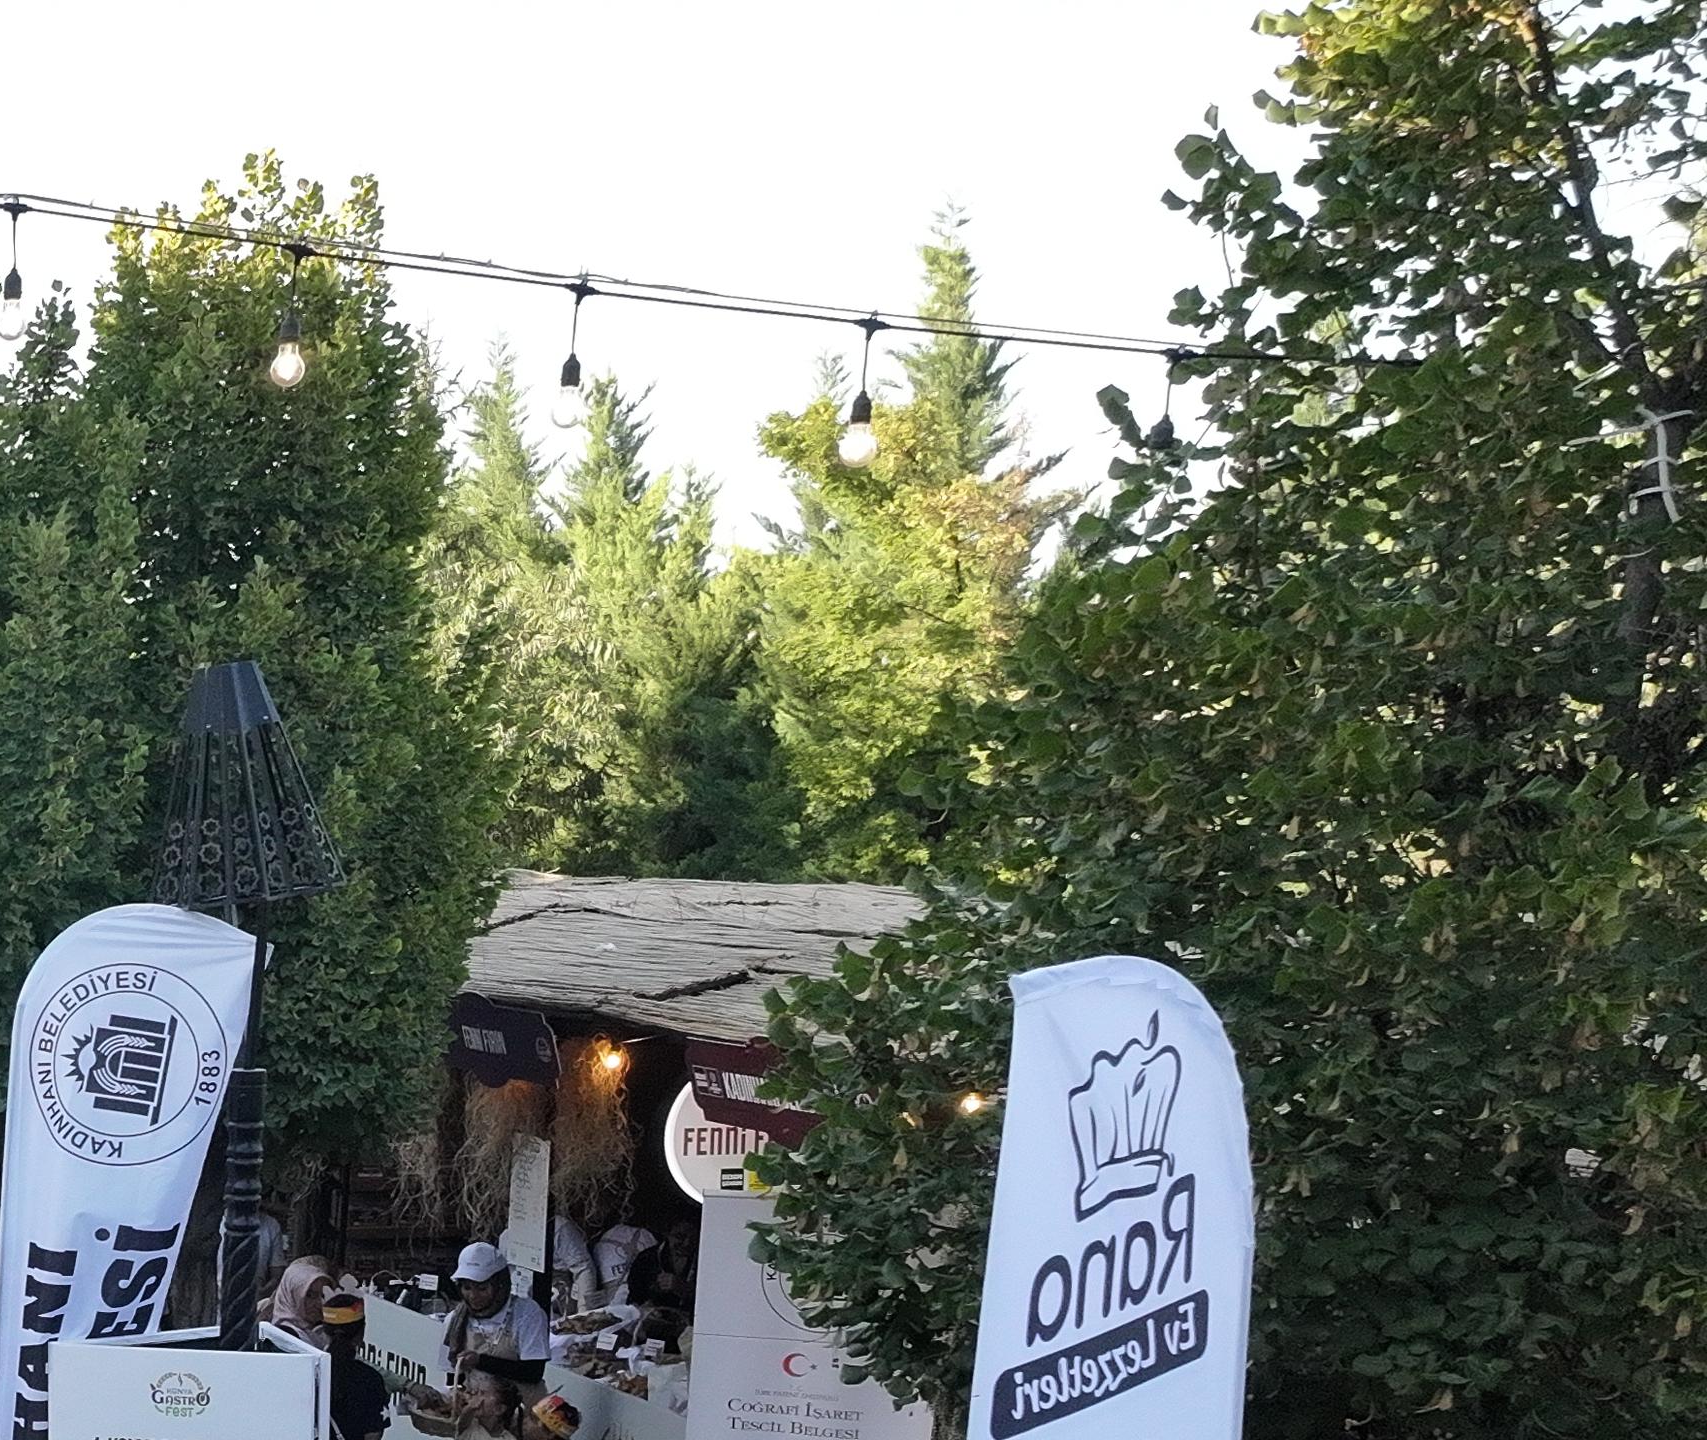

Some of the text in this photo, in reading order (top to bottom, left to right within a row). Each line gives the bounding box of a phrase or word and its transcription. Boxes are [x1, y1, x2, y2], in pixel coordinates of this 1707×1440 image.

[37, 970, 159, 1159] KADINHANI BELEDİYESİ
[194, 1050, 221, 1107] 1883
[151, 1386, 212, 1407] GASTRO
